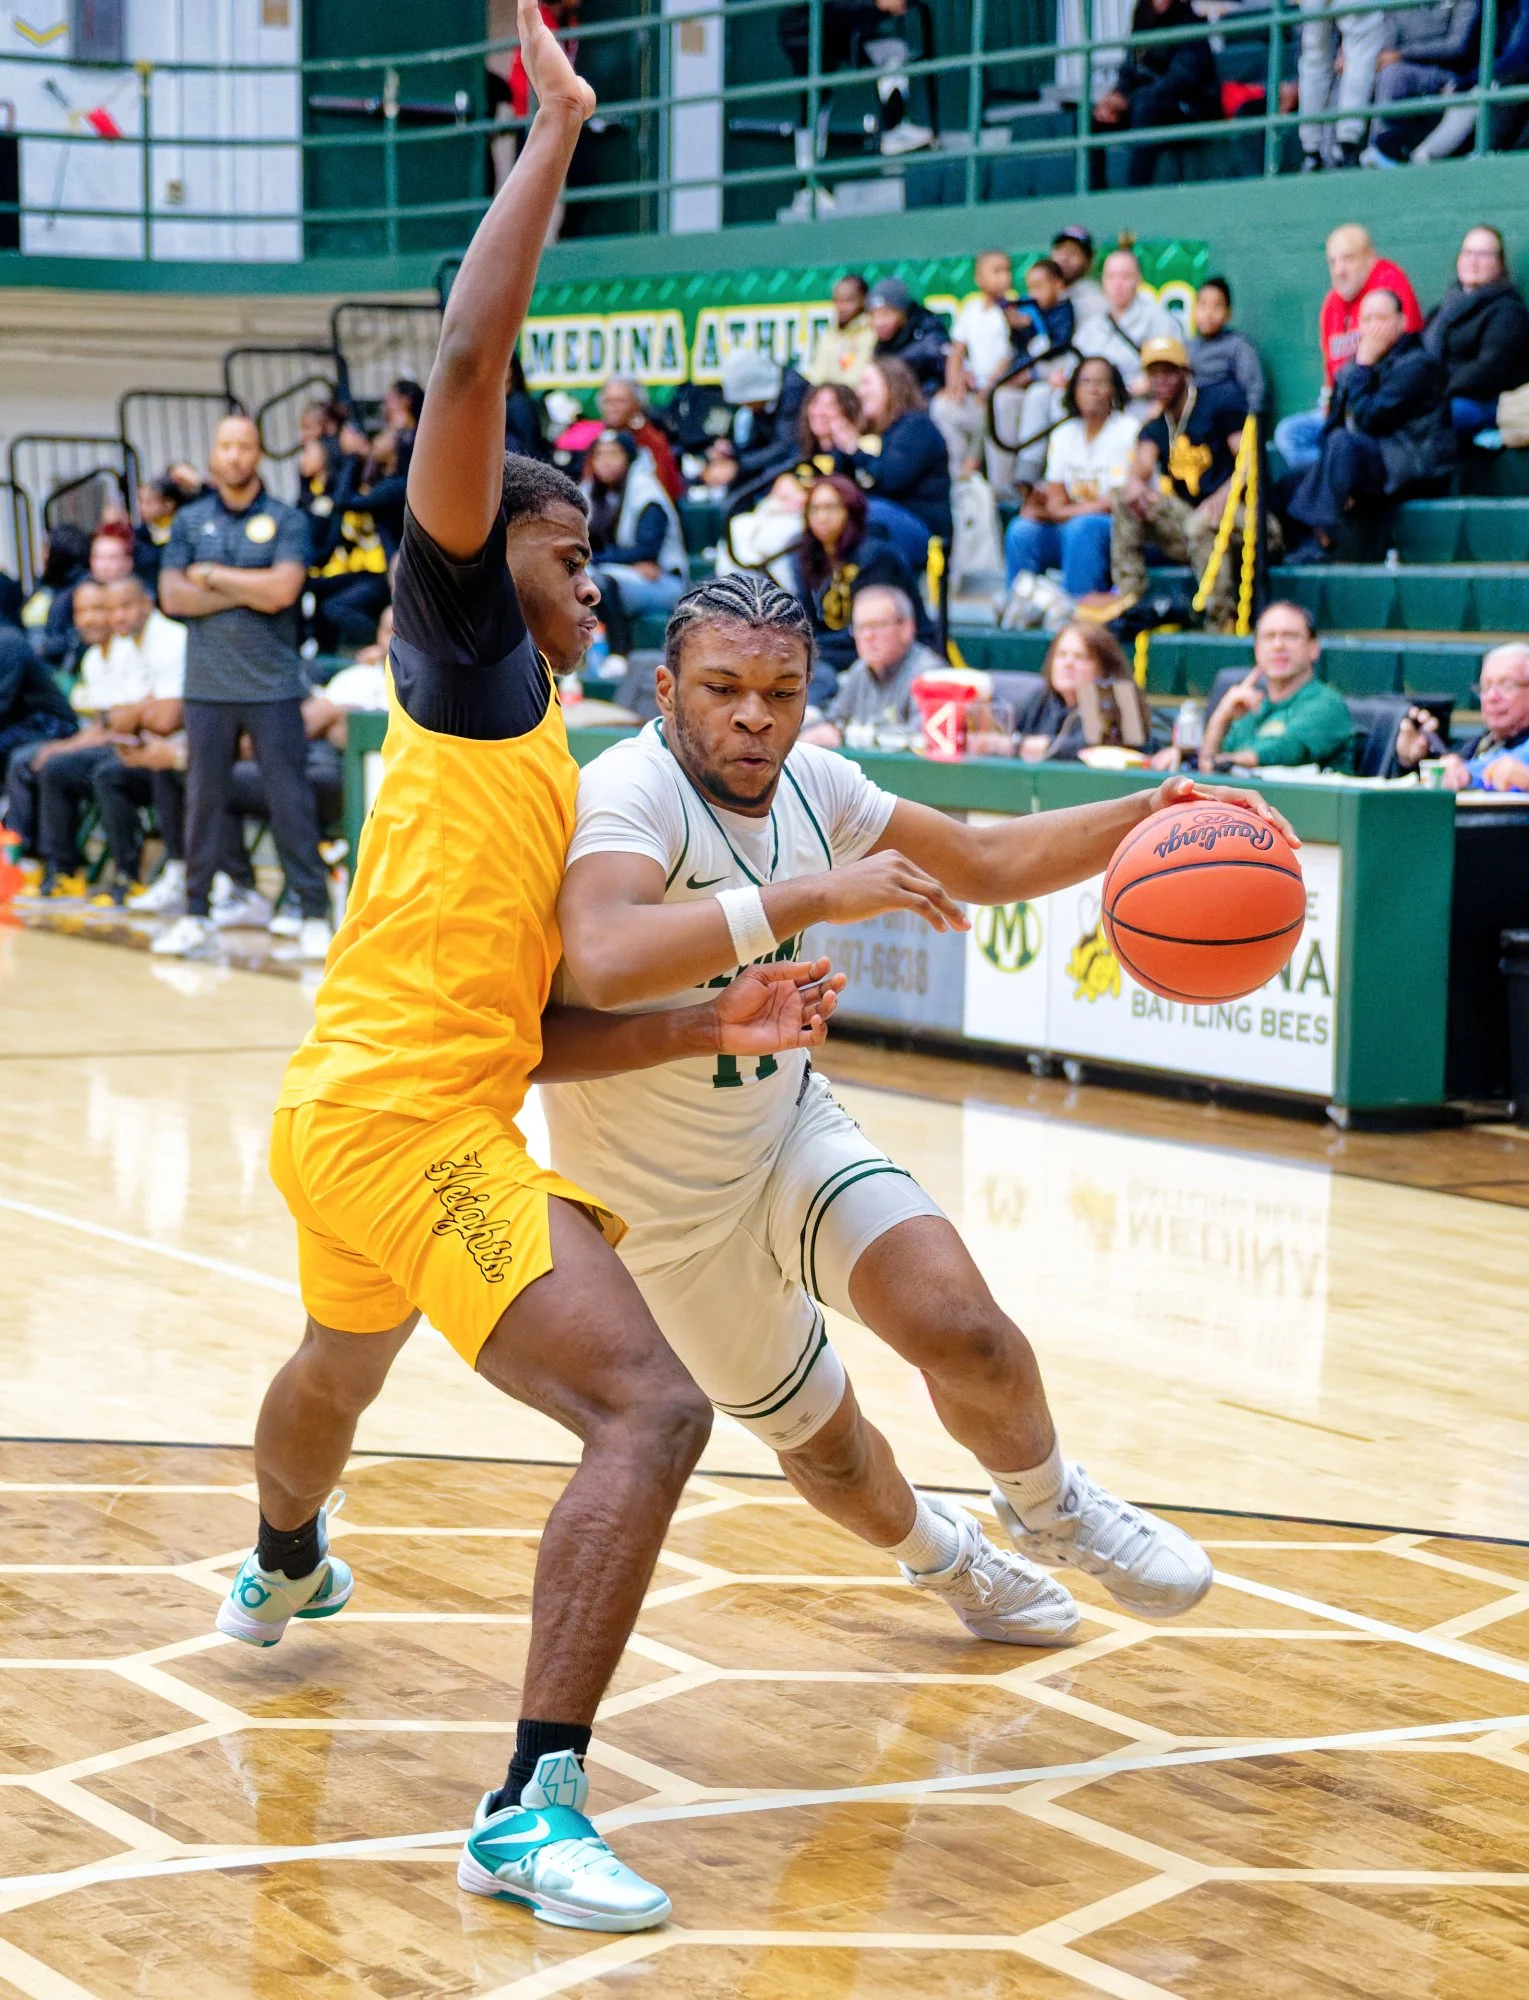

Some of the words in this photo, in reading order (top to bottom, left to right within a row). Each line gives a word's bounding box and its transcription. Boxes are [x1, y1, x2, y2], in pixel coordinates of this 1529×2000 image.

[526, 318, 681, 373] MEDINA
[1153, 822, 1274, 858] Rawlings
[1131, 989, 1252, 1034] BATTLING
[1259, 1007, 1328, 1046] BEES
[425, 1150, 512, 1283] Heights
